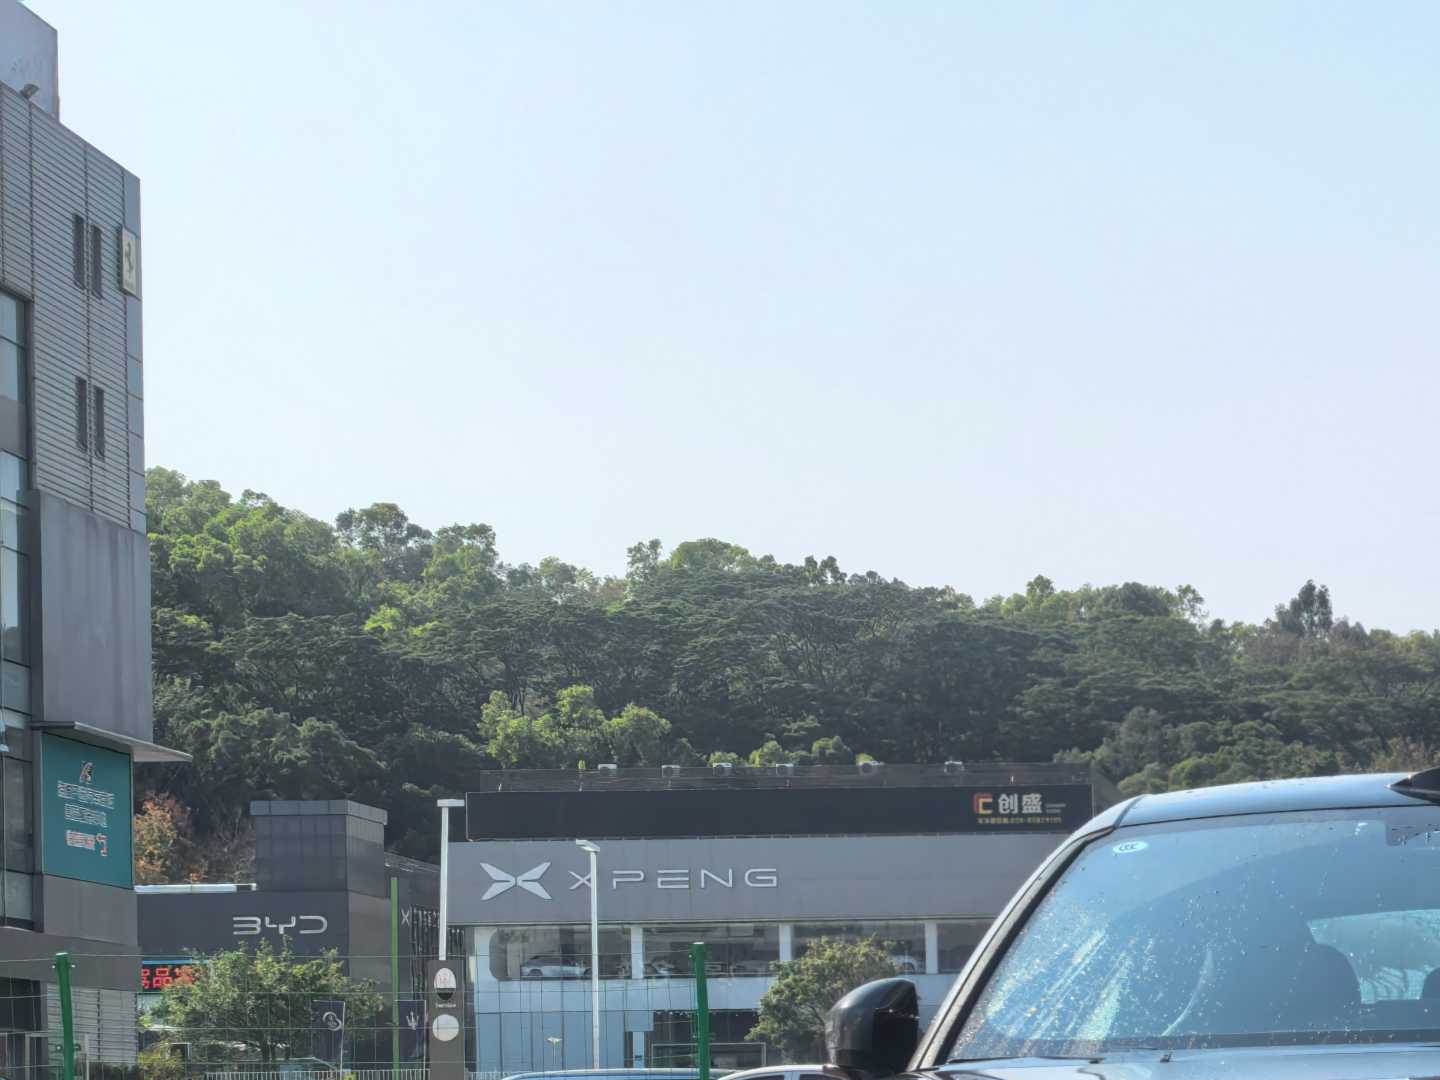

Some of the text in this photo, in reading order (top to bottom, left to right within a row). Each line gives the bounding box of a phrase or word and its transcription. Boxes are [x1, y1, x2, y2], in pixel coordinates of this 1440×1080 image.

[998, 794, 1042, 814] 创盛
[568, 867, 778, 891] XPENG
[232, 914, 328, 935] BYD
